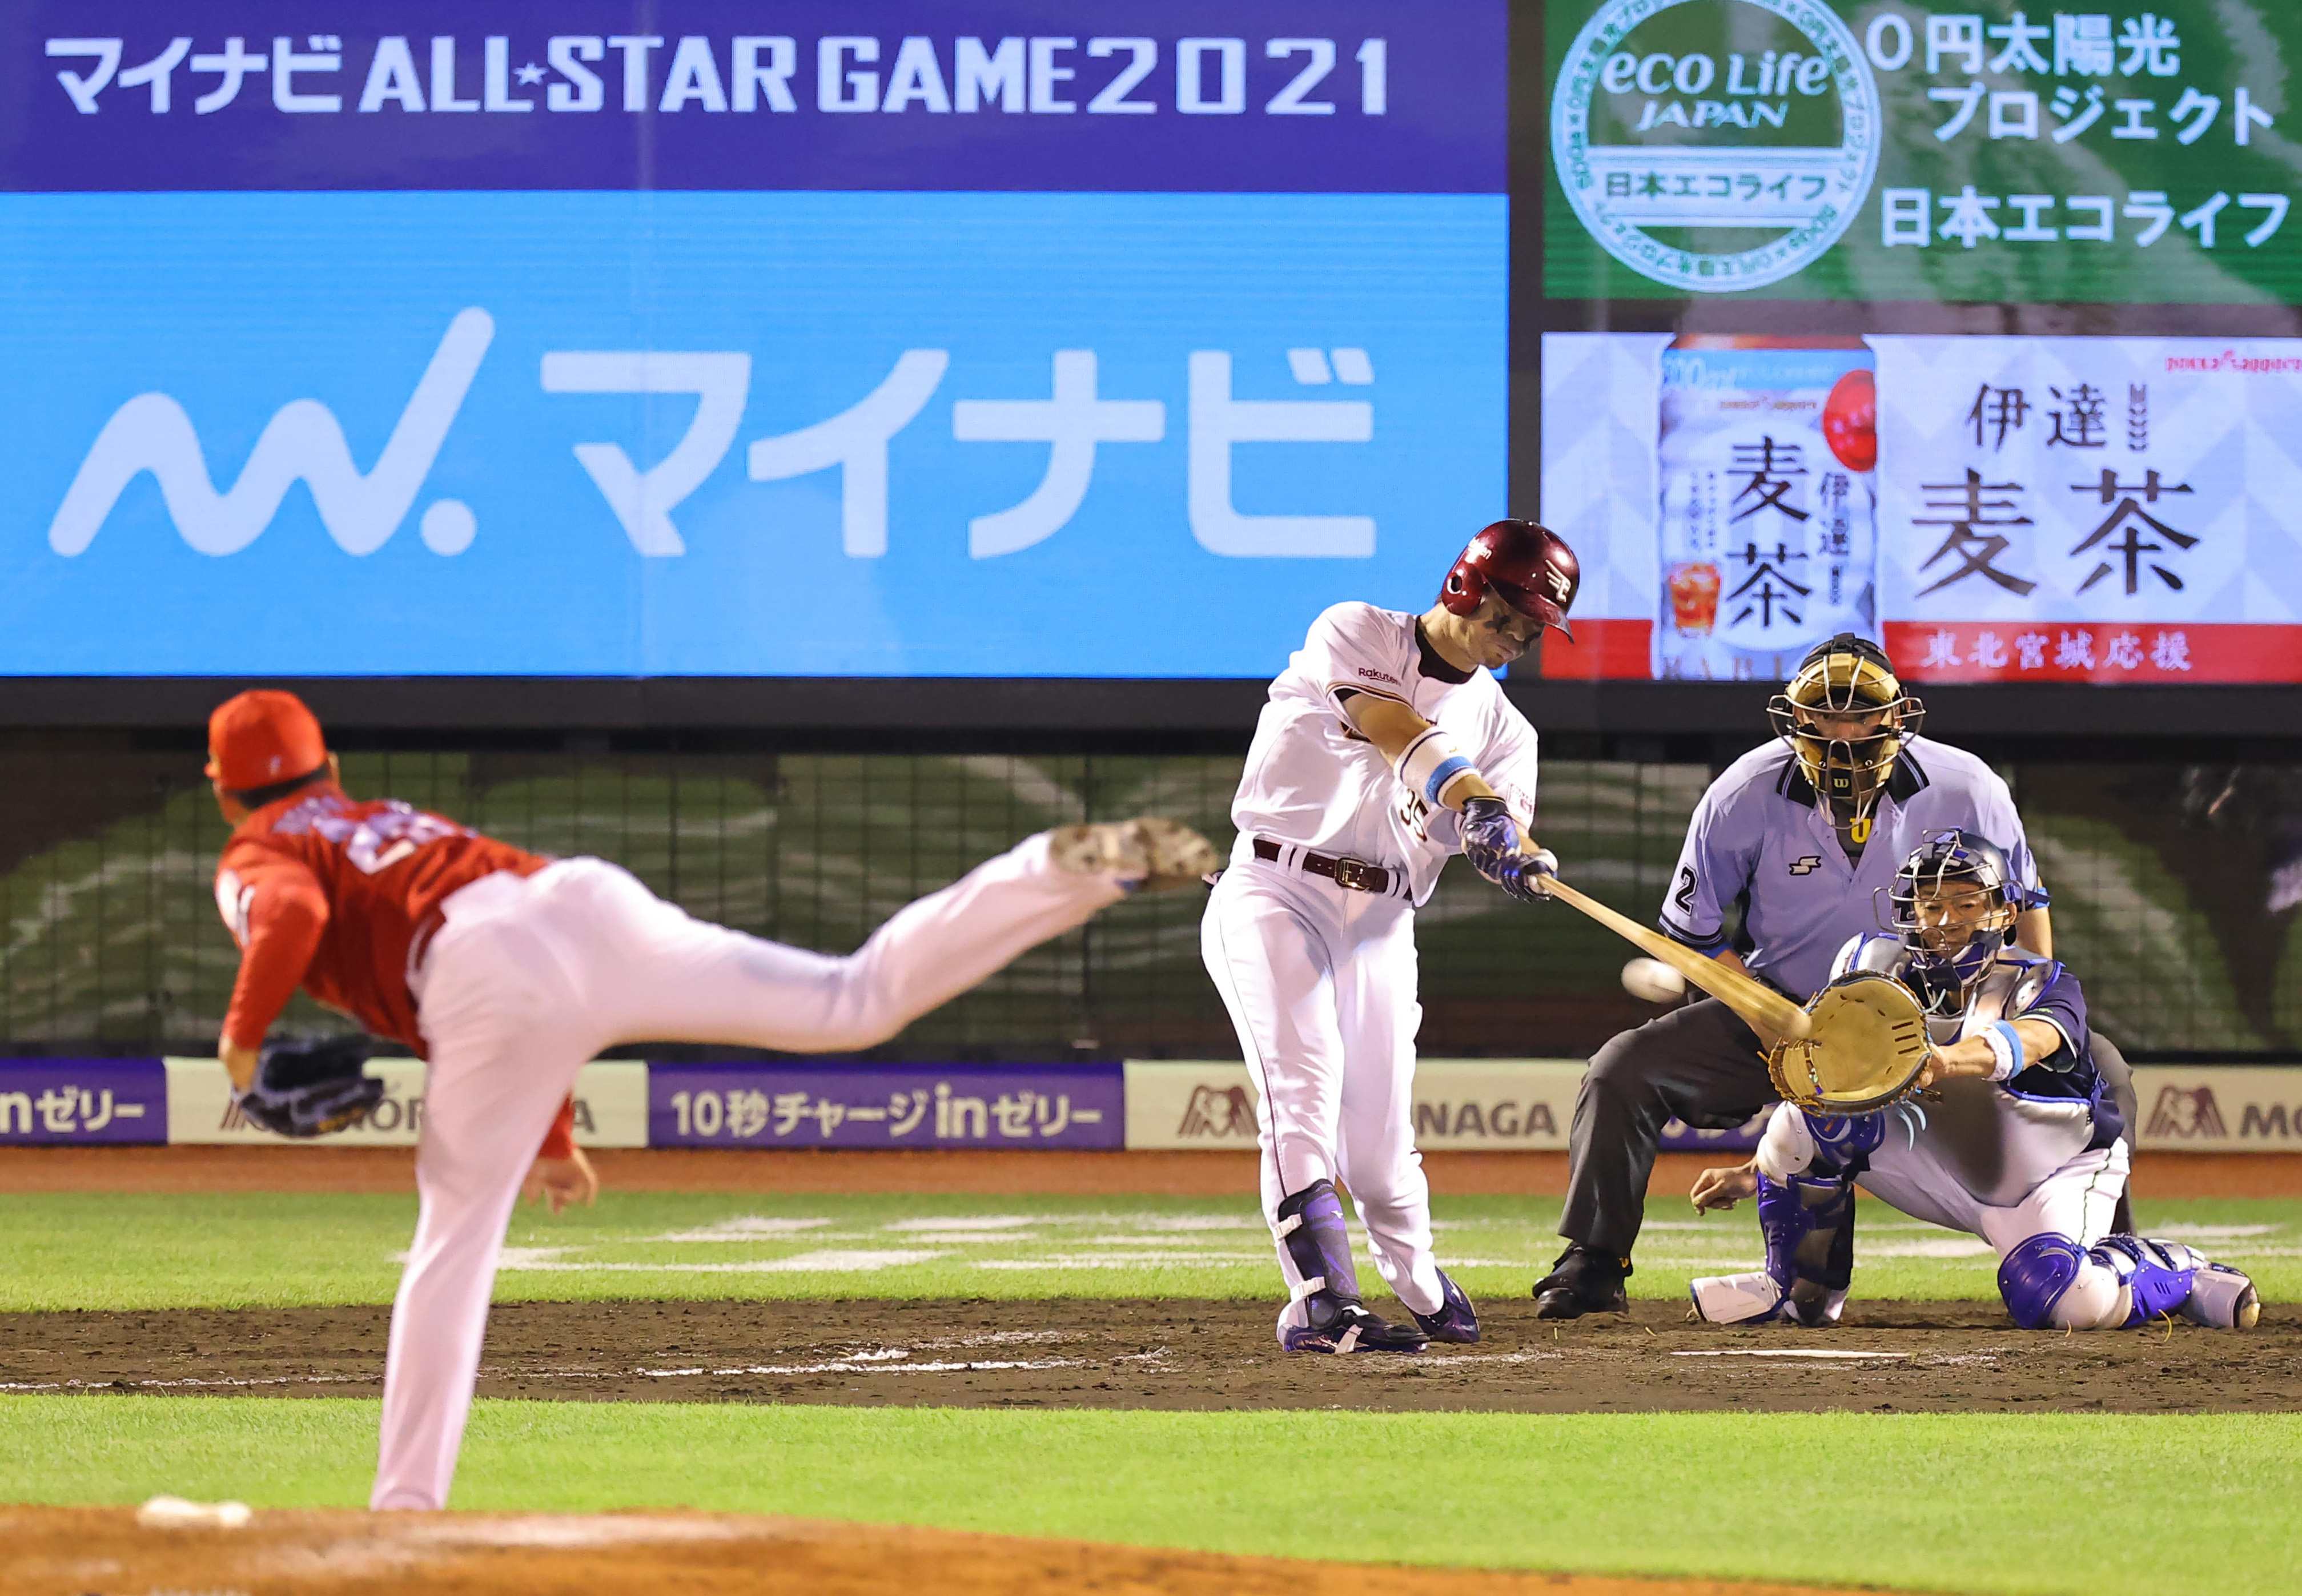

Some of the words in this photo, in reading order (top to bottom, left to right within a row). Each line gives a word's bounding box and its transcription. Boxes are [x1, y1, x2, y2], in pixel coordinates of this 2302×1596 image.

[45, 35, 341, 114] マイナビ
[1601, 51, 1714, 95] eco
[1727, 50, 1828, 95] Life
[1636, 99, 1789, 131] JAPAN
[1927, 81, 2273, 146] プロジェクト
[1607, 171, 1826, 201] 日本エコライフ
[1882, 185, 2289, 248] 日本エコライフ
[1968, 383, 2107, 451] 伊達
[540, 347, 1377, 560] マイナビ
[1726, 436, 1810, 628] 麦茶
[1912, 468, 2200, 599] 麦茶
[1921, 629, 2192, 672] 東北宮城応援
[1673, 862, 1699, 916] 2
